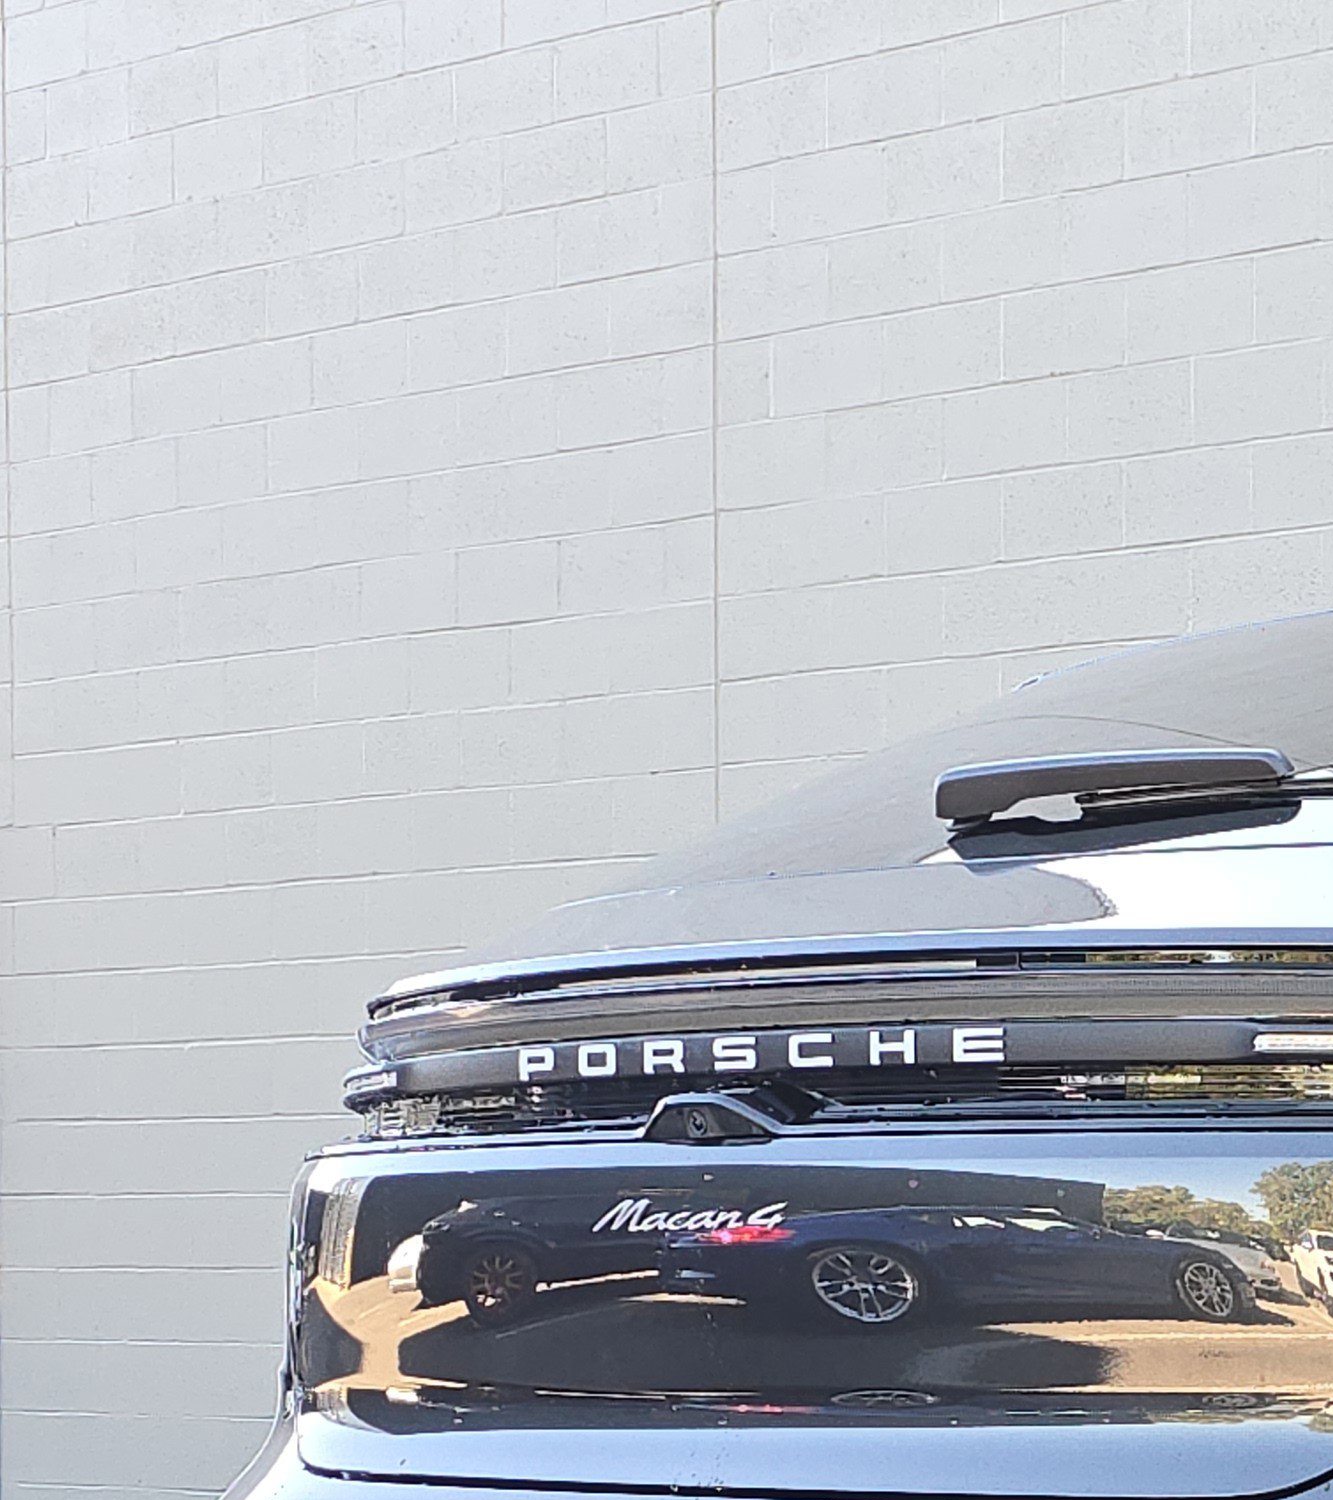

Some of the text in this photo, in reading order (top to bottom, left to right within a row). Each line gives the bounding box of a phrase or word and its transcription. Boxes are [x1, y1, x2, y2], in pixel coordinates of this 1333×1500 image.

[518, 1027, 1005, 1081] PORSCHE
[592, 1199, 788, 1233] Macan 4
